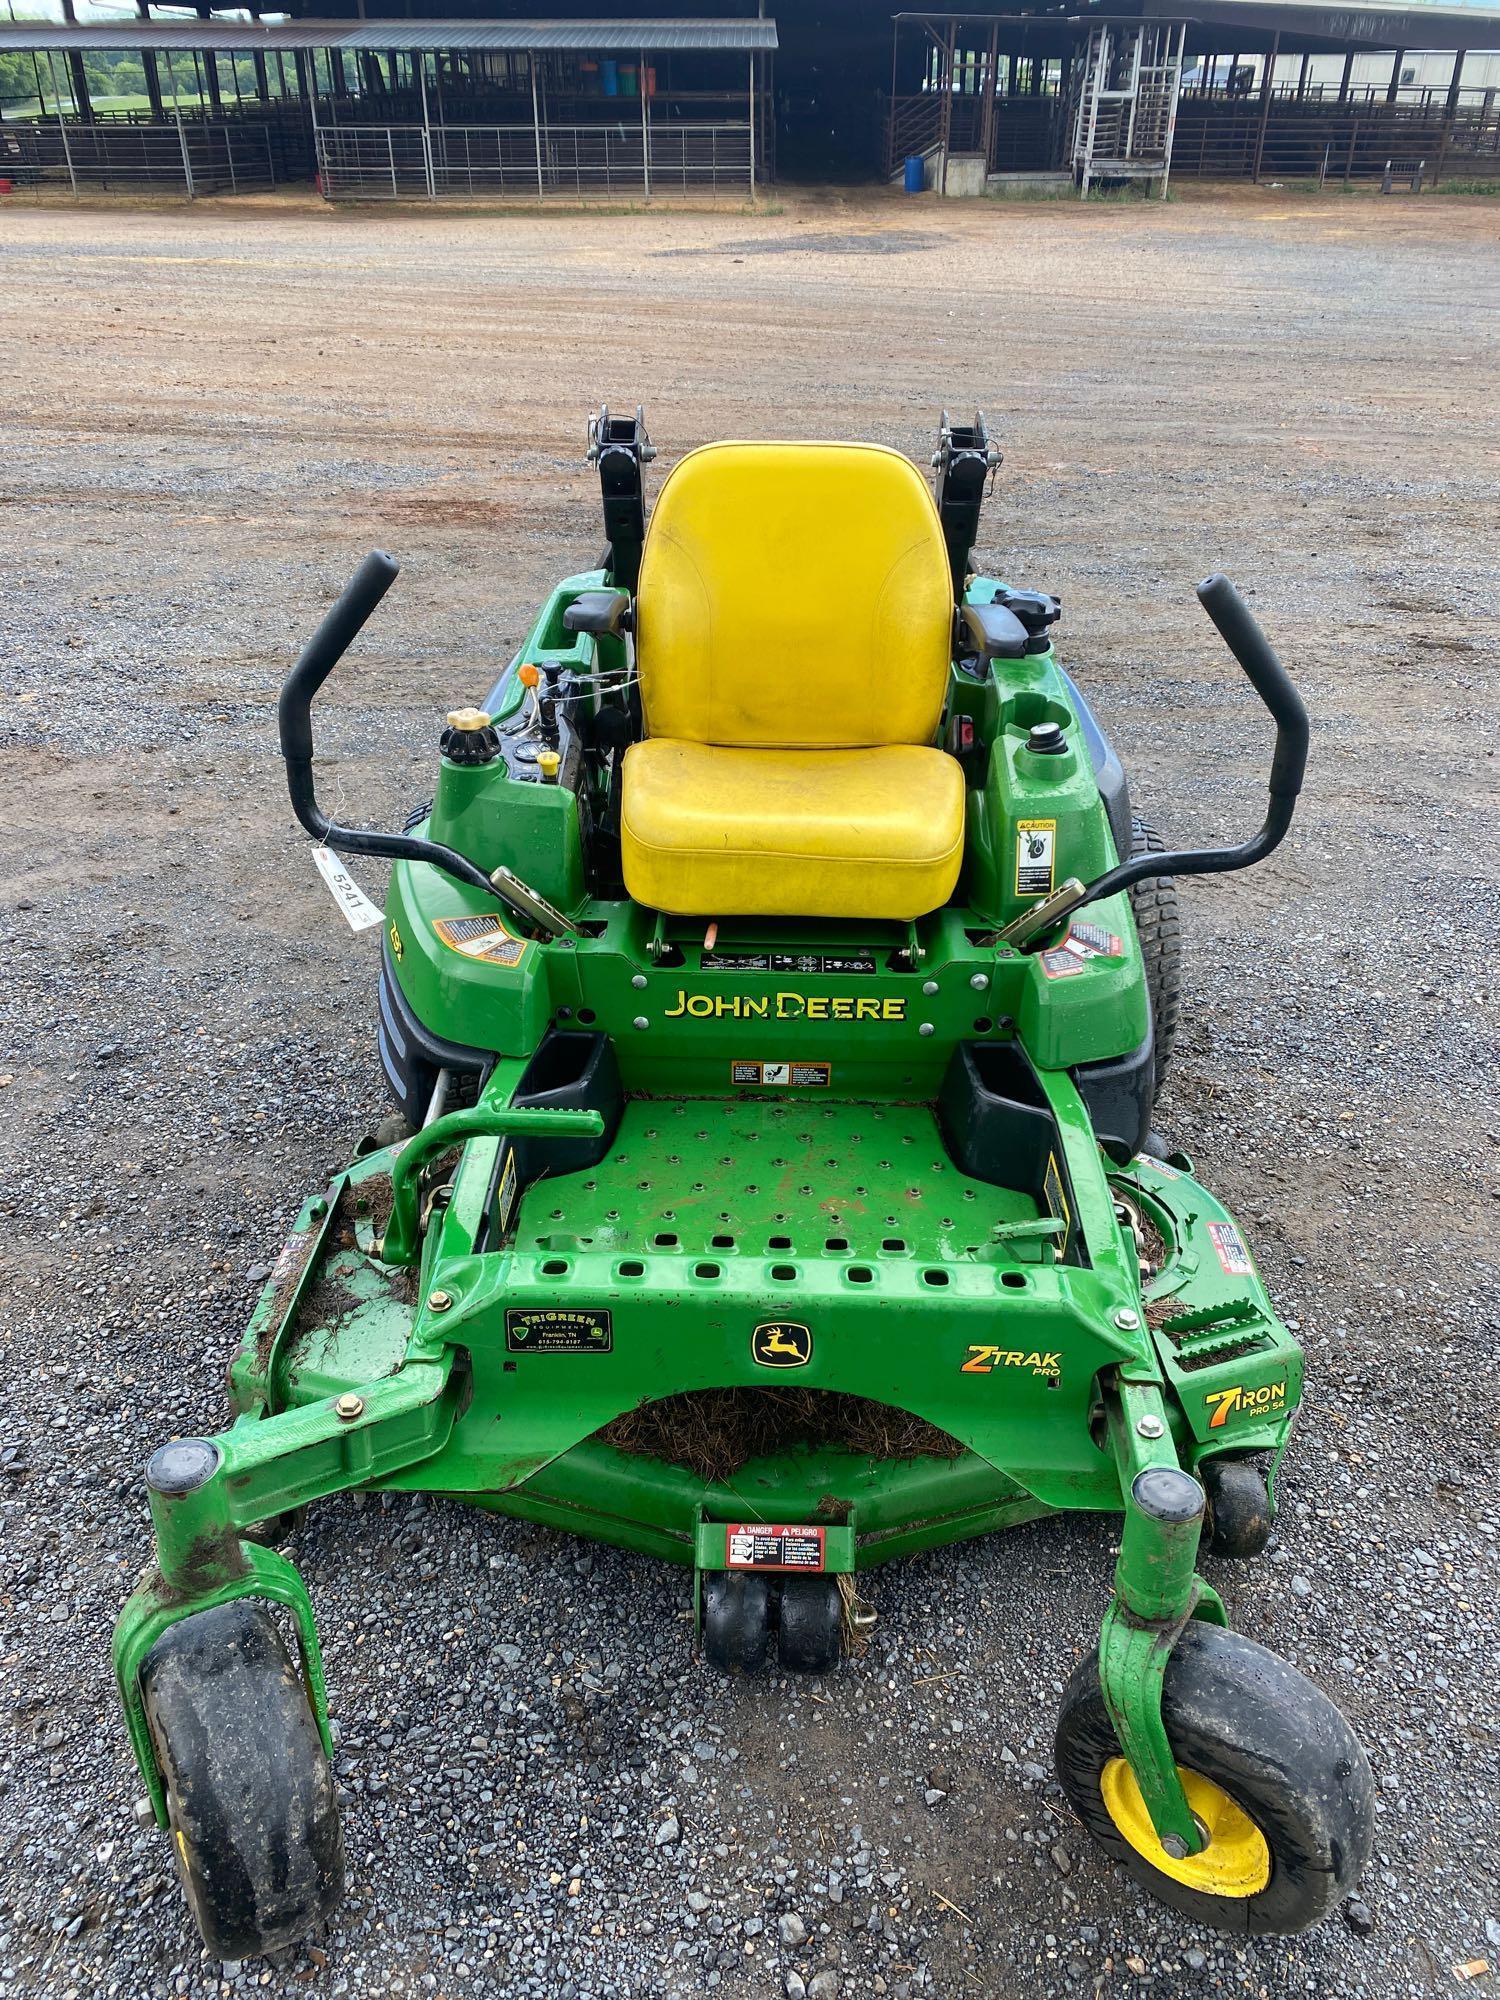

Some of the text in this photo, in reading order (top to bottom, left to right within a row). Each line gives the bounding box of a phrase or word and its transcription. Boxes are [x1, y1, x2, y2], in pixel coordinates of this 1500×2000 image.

[333, 873, 365, 908] 5241
[664, 990, 906, 1020] JOHN DEERE
[1032, 1368, 1060, 1376] PRO
[1249, 1400, 1285, 1417] PRO 54
[747, 1526, 773, 1535] DANGER
[790, 1528, 818, 1536] PELIGRO
